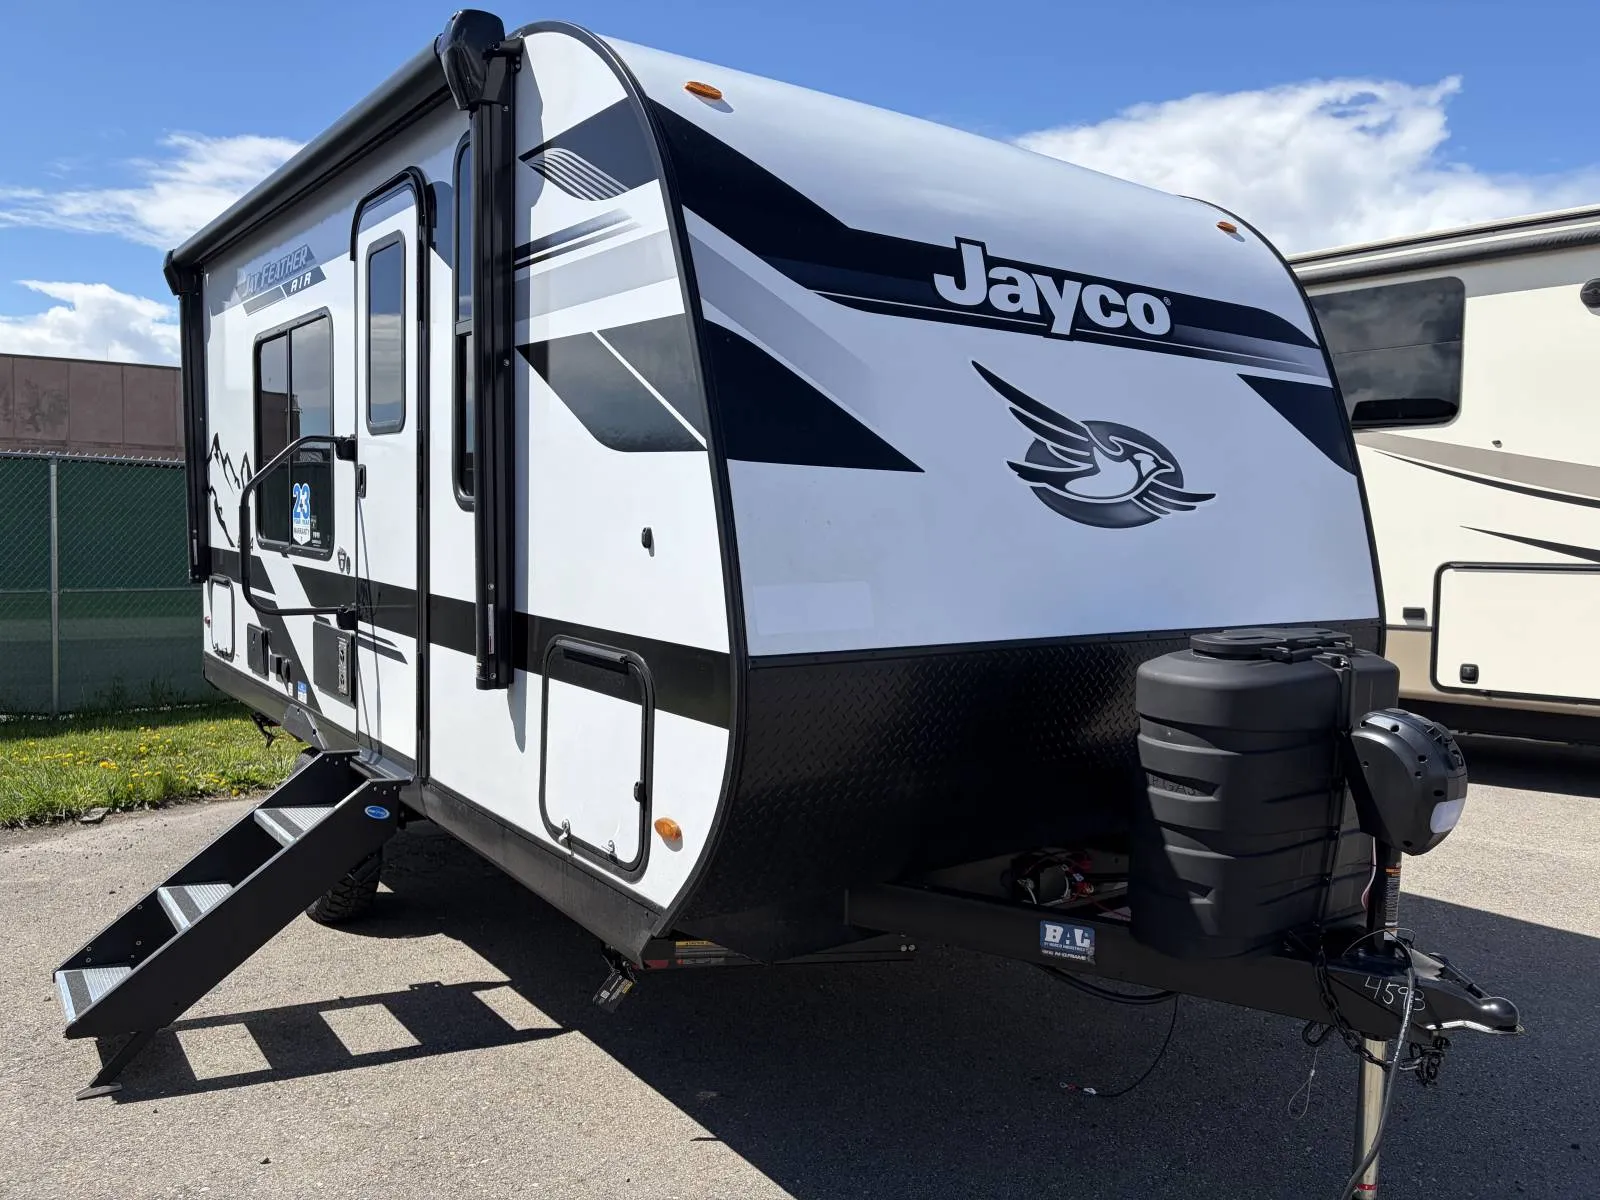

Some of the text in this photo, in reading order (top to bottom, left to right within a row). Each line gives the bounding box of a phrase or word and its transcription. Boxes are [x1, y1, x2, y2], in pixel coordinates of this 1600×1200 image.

[242, 246, 308, 297] JAY FEATHER
[290, 271, 312, 292] AIR
[934, 242, 1171, 336] Jayco
